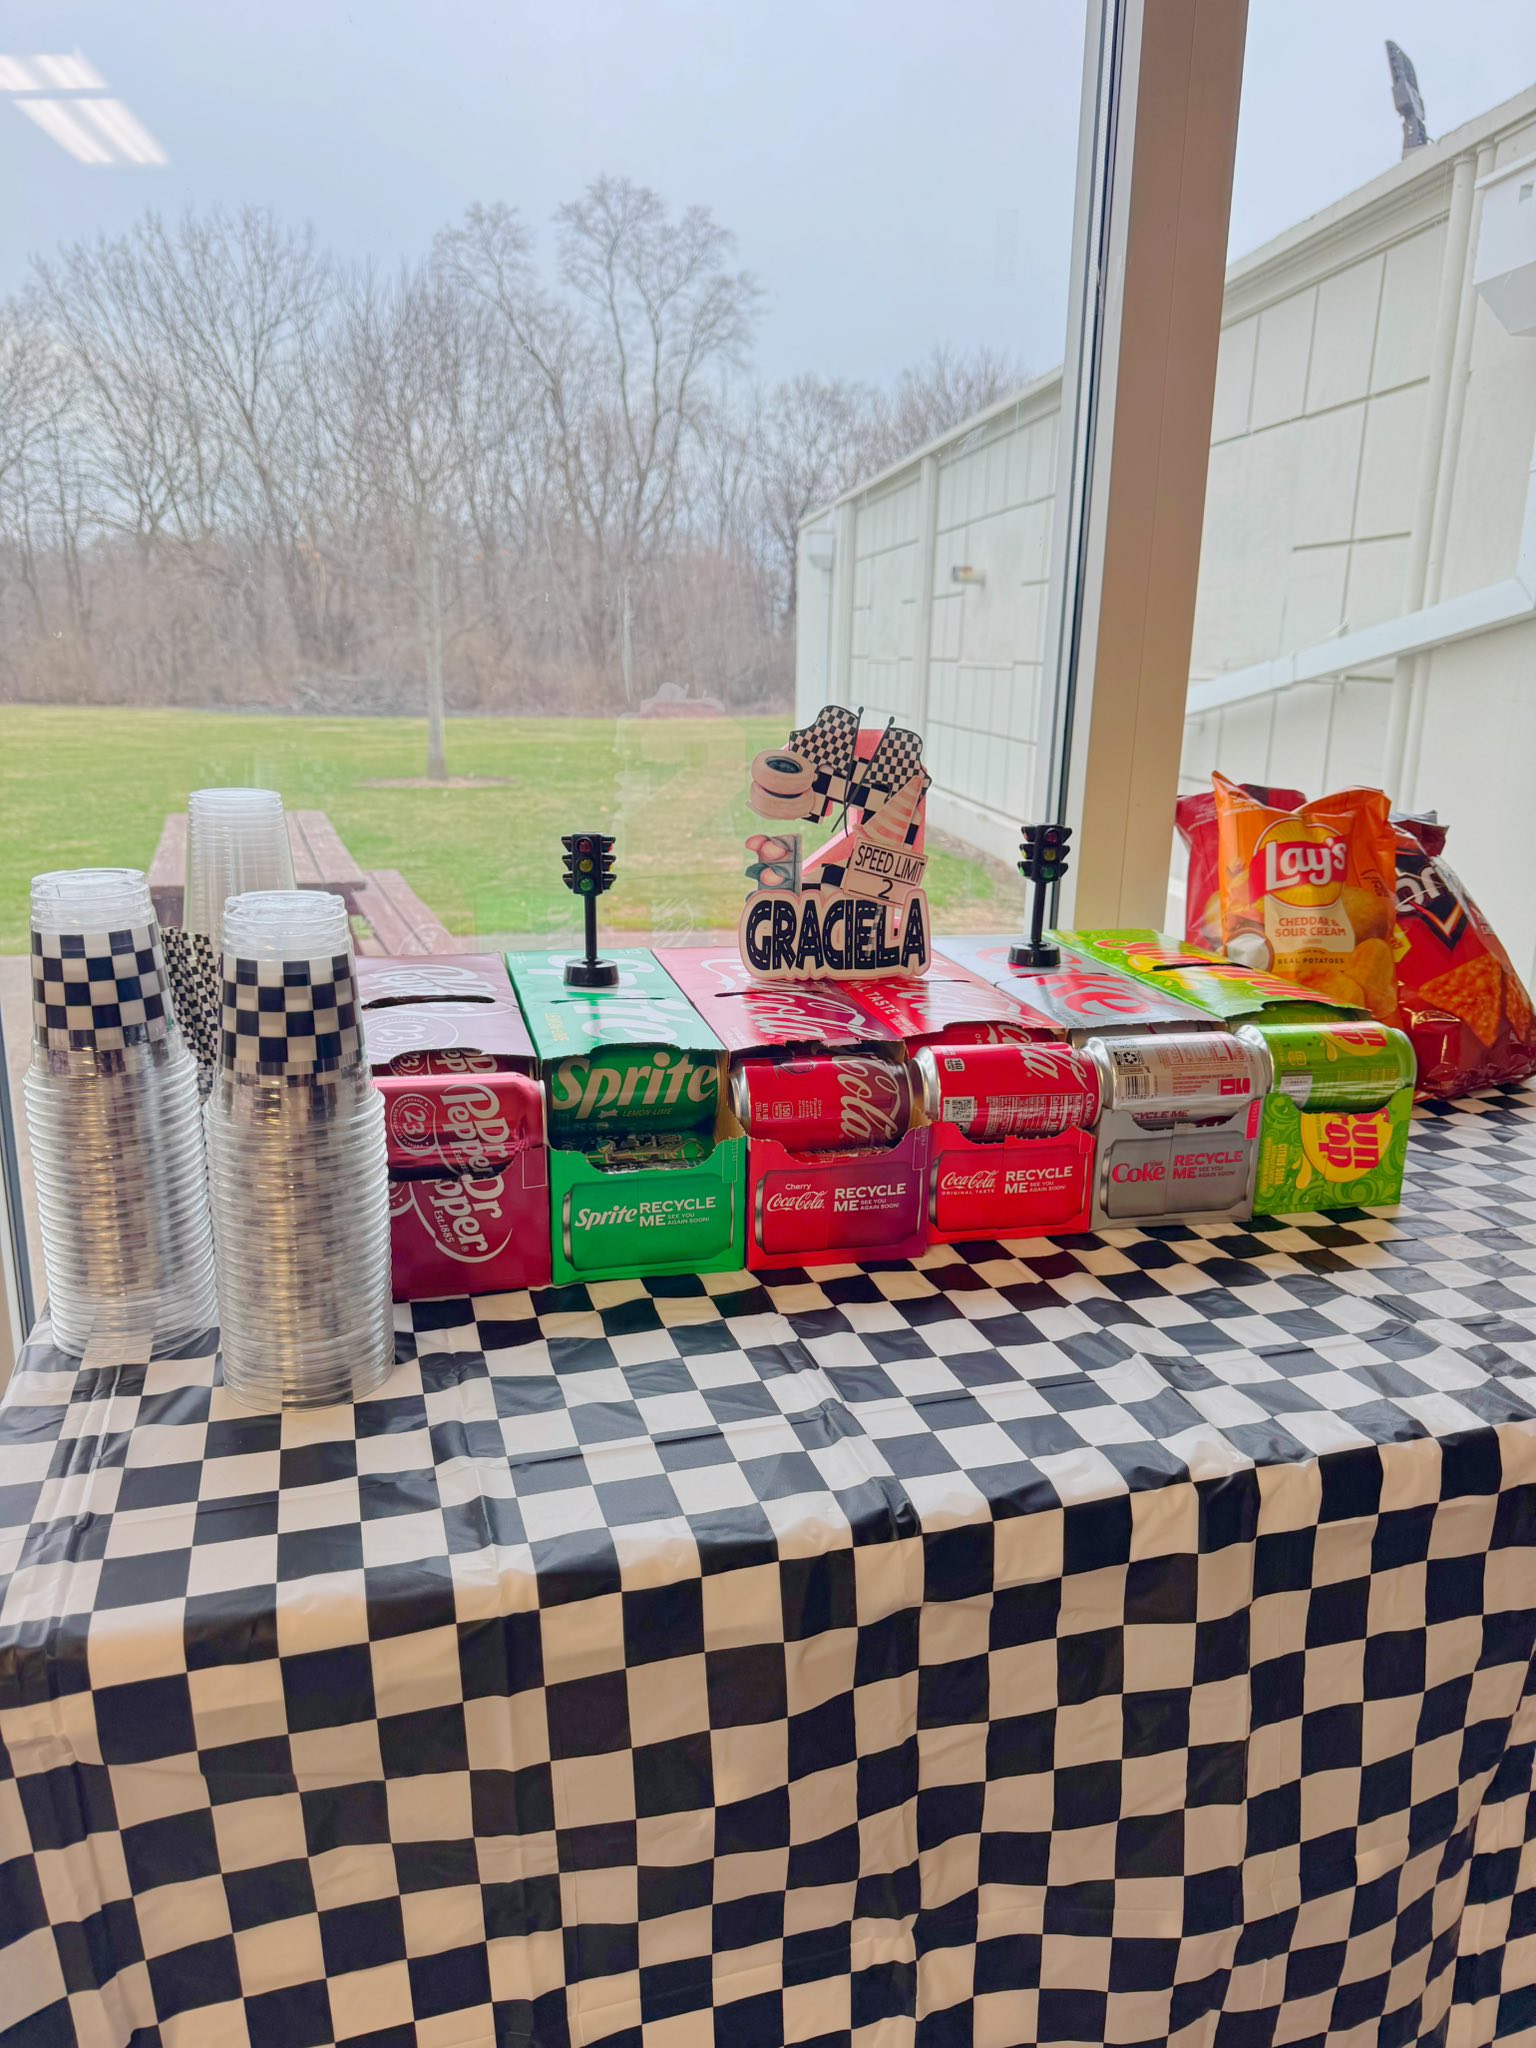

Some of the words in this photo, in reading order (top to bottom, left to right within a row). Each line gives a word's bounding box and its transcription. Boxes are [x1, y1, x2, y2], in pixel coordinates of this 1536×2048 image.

[855, 844, 894, 873] SPEED
[894, 855, 926, 882] LIMIT
[1266, 837, 1346, 891] Lay's
[878, 879, 894, 900] 2
[1275, 927, 1307, 937] SOUR
[1309, 926, 1346, 936] CREAM
[1278, 917, 1328, 927] CHEDDAR
[745, 898, 926, 971] GRACIELA
[865, 991, 898, 1016] TASTE
[552, 1051, 719, 1120] Sprite
[831, 1056, 900, 1140] Cola
[402, 1109, 427, 1135] 23
[622, 1107, 673, 1118] LEMON-LIME
[1132, 1110, 1169, 1120] CYCLE
[1170, 1110, 1190, 1118] ME
[440, 1083, 500, 1179] Pepper
[473, 1117, 510, 1159] Dr
[1173, 1151, 1243, 1167] RECYCLE
[941, 1169, 999, 1190] Coca-Cola
[1005, 1166, 1073, 1182] RECYCLE
[1112, 1161, 1166, 1184] Coke
[1172, 1166, 1198, 1180] ME
[462, 1174, 505, 1220] Dr
[785, 1183, 812, 1191] Cherry
[834, 1183, 906, 1199] RECYCLE
[1004, 1182, 1028, 1194] ME
[639, 1196, 716, 1214] RECYCLE
[766, 1190, 828, 1212] Coca-Cola
[833, 1199, 859, 1212] ME
[420, 1178, 489, 1253] pper
[574, 1205, 638, 1231] Sprite
[639, 1213, 666, 1227] ME
[667, 1218, 688, 1226] AGAIN
[433, 1209, 456, 1244] Est.1885
